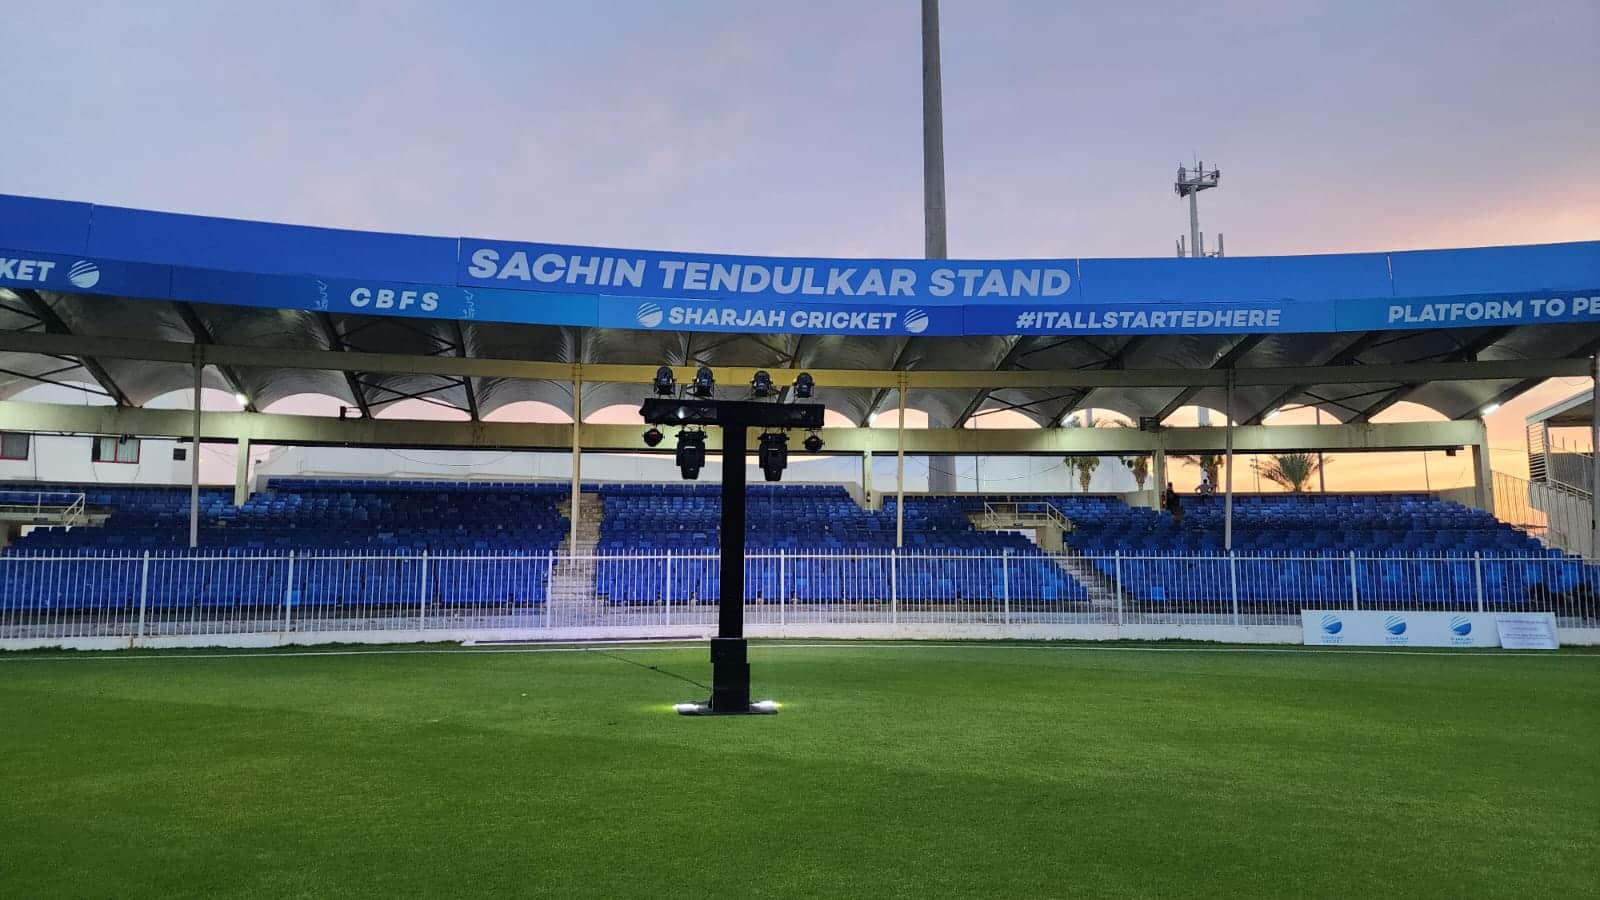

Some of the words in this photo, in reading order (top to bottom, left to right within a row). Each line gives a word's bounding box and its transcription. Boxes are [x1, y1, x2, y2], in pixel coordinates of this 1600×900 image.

[468, 248, 646, 287] SACHIN
[659, 261, 917, 297] TENDULKAR
[928, 269, 1070, 297] STAND
[350, 287, 439, 312] CBFS
[1388, 301, 1523, 323] PLATFORM
[1529, 298, 1566, 318] TO
[669, 307, 786, 328] SHARJAH
[791, 311, 897, 329] CRICKET
[1016, 310, 1281, 329] #ITALLSTARTEDHERE
